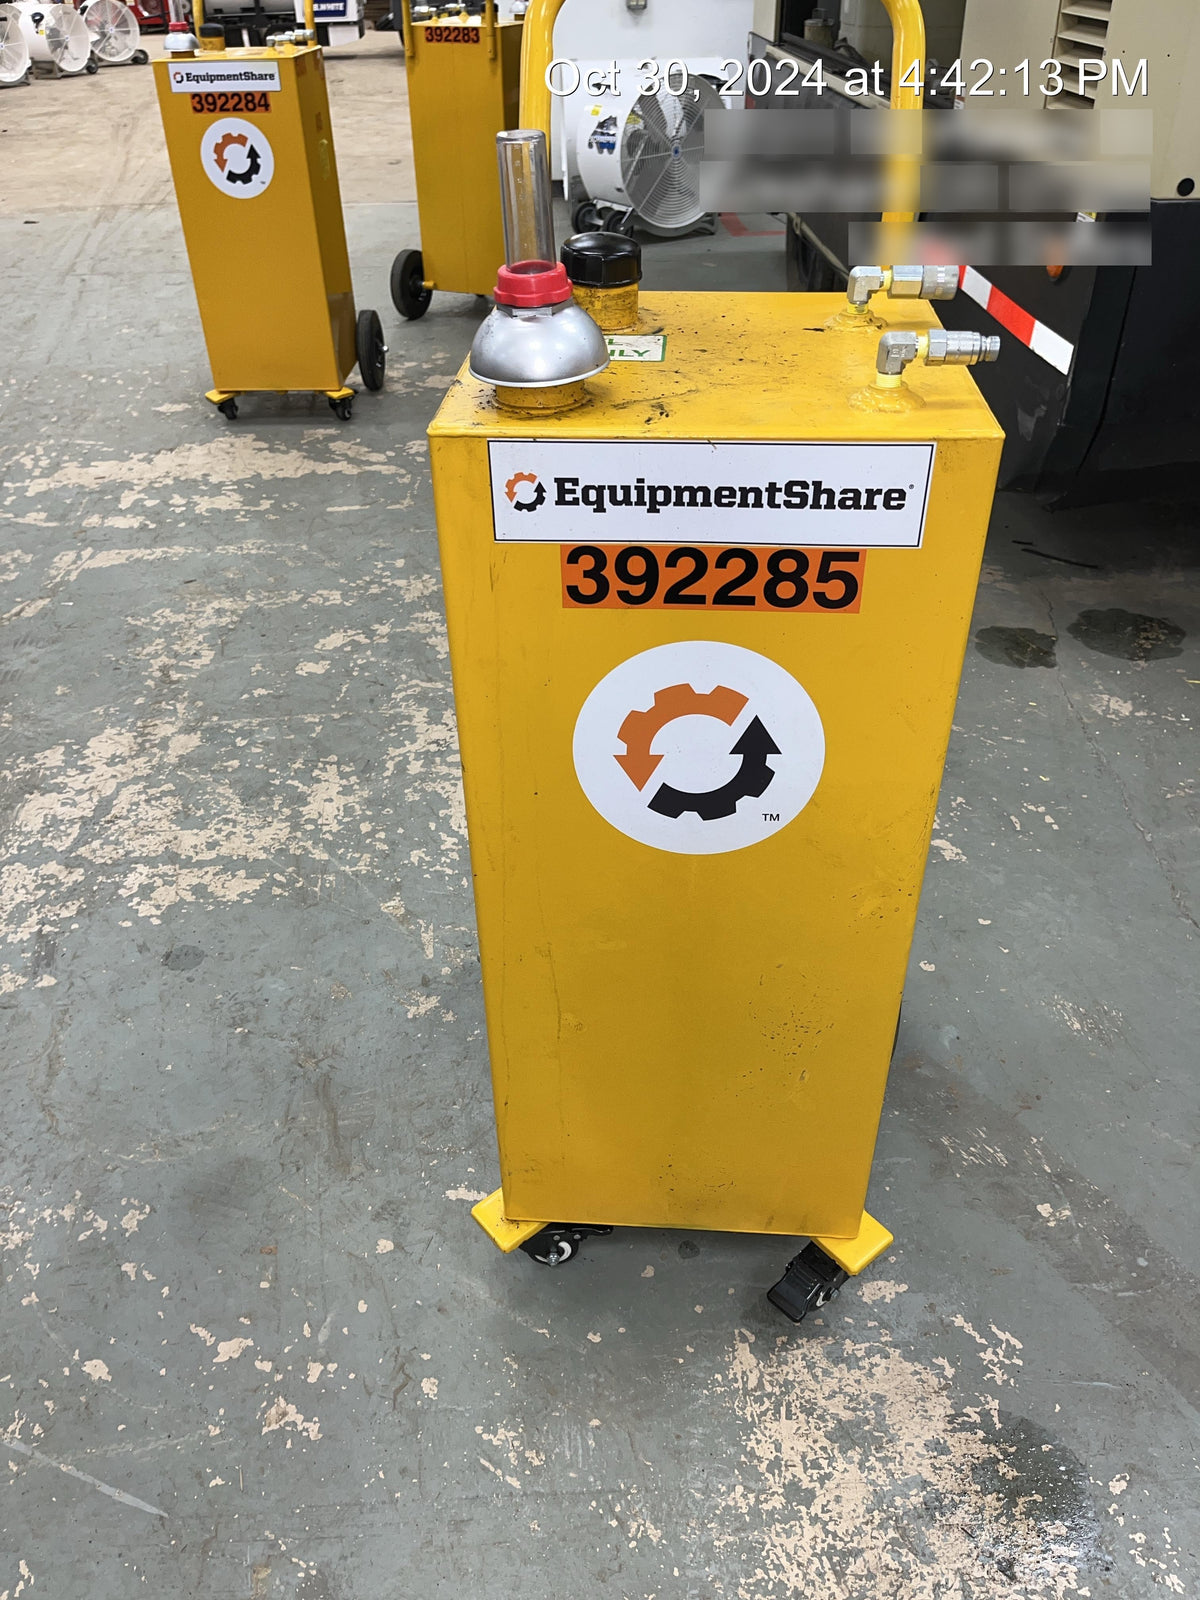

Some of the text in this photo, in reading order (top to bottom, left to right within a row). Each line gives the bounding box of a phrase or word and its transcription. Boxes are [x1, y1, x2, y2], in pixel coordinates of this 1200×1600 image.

[425, 26, 480, 44] 392283
[185, 71, 275, 84] EquipmentShare
[191, 92, 270, 113] 392284
[565, 545, 860, 609] 392285
[762, 813, 780, 822] TM
